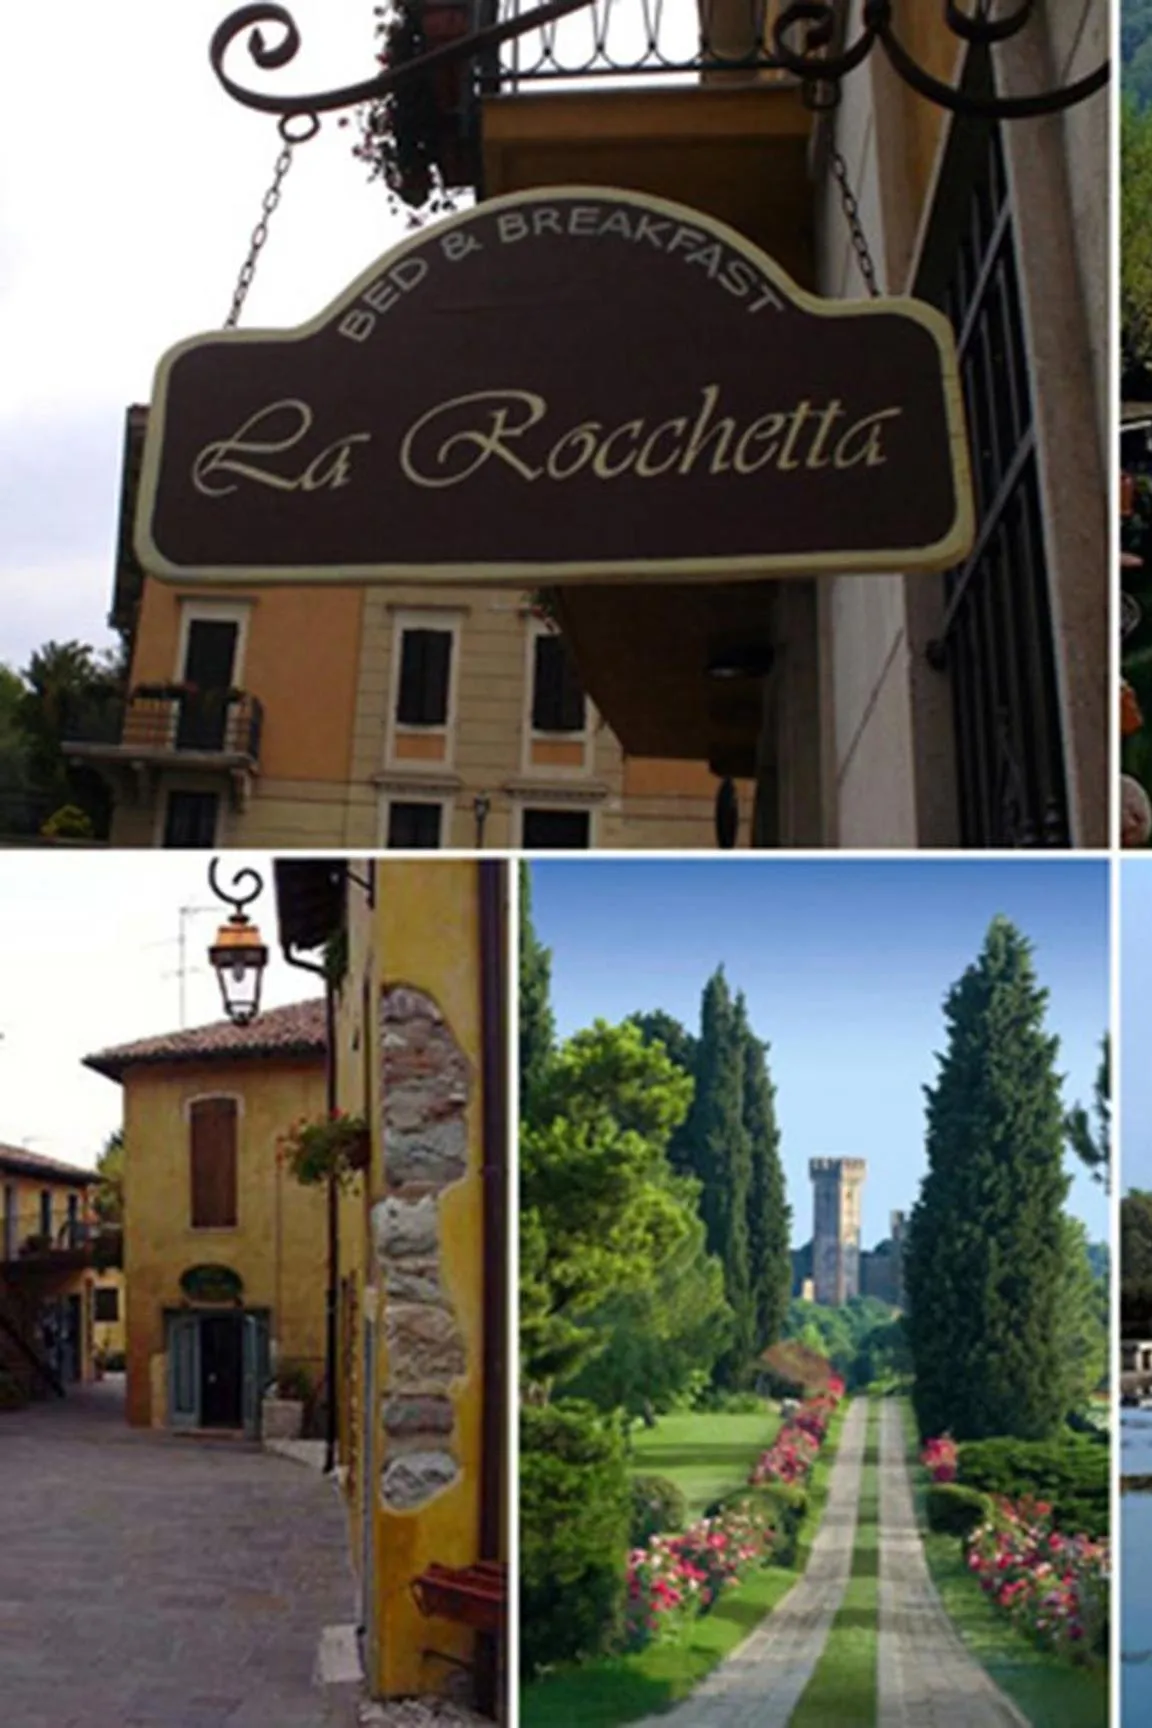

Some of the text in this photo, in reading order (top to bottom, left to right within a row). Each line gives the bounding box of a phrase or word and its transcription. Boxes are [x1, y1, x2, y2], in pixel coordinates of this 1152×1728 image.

[338, 207, 785, 343] BED & BREAKFAST
[191, 384, 901, 497] La Rocchetta
